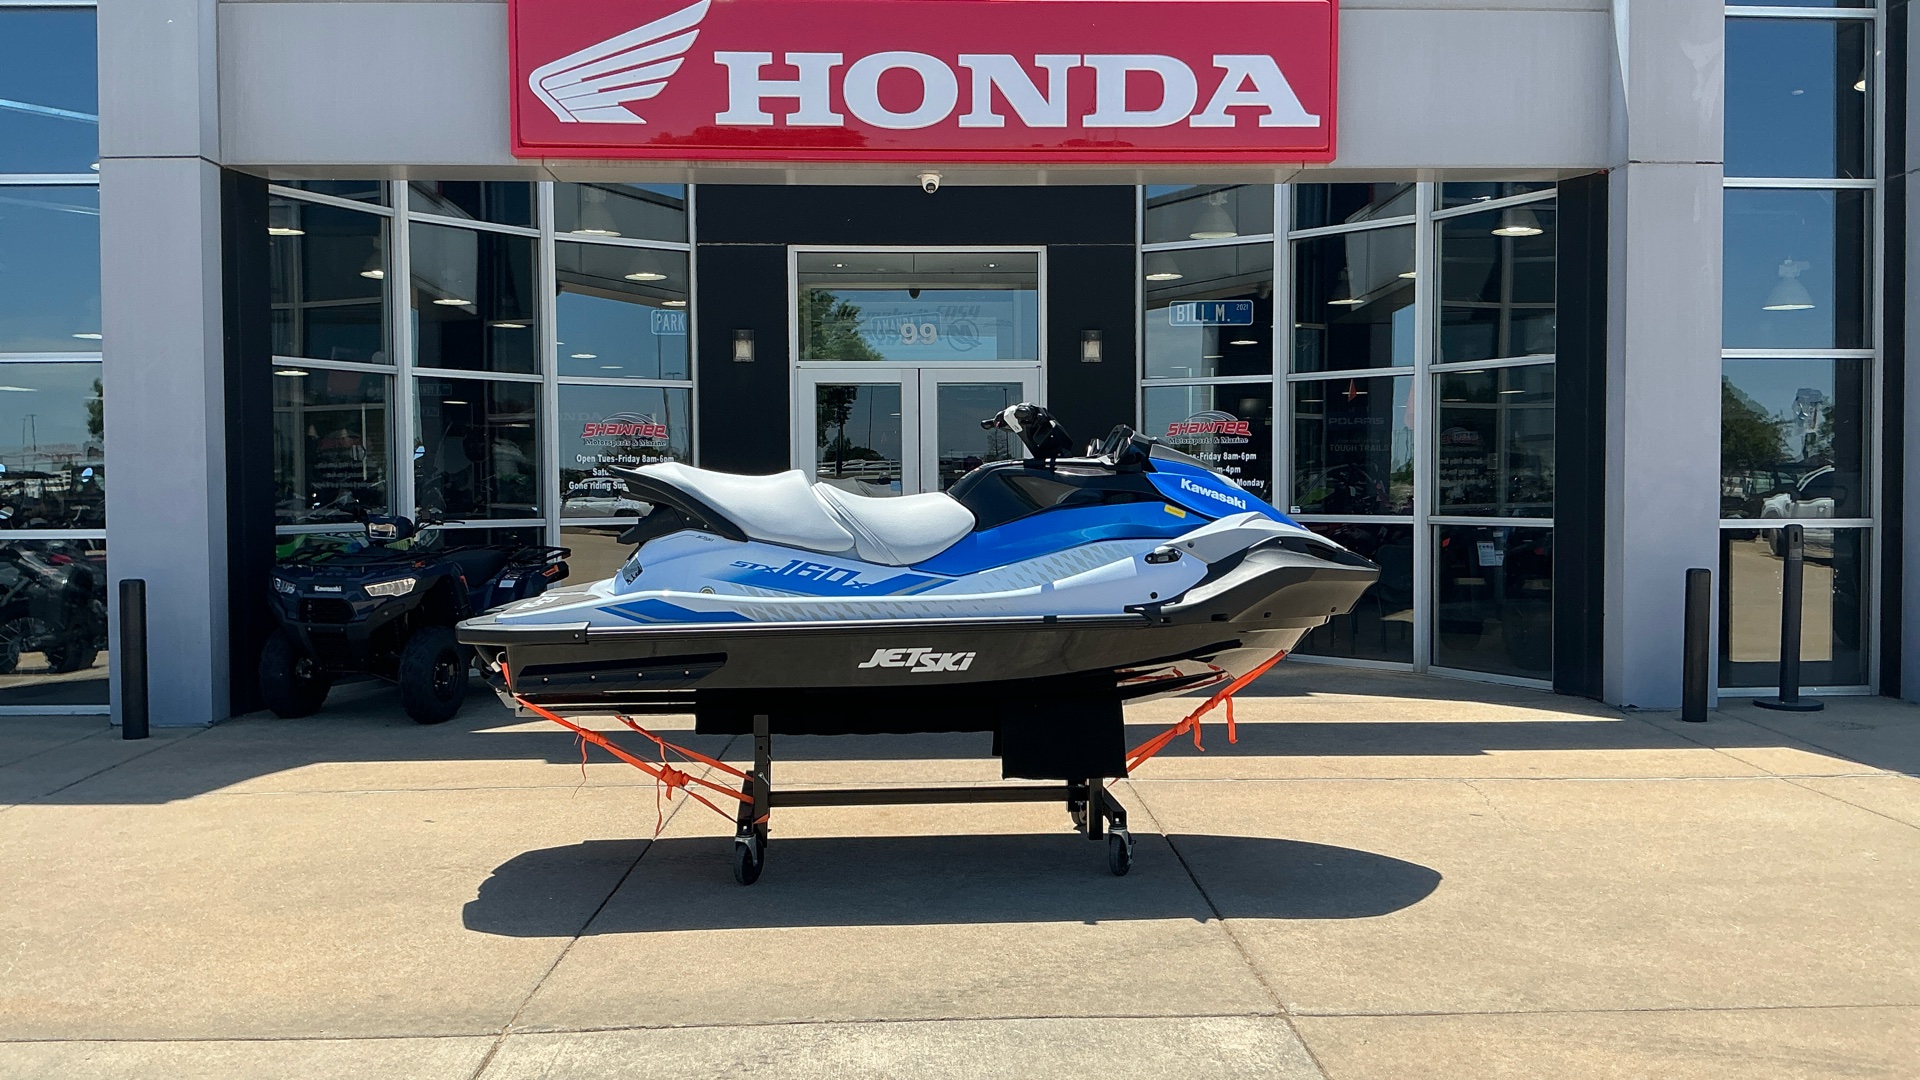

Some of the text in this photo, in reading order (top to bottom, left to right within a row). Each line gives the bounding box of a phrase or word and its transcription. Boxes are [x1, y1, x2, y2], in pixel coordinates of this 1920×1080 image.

[714, 51, 1321, 128] HONDA
[1236, 303, 1249, 311] 2021
[1176, 304, 1231, 322] BILL M.
[656, 313, 685, 331] PARK
[901, 323, 938, 345] 99
[1328, 417, 1385, 425] POLARIS
[585, 439, 631, 447] Motorsports
[1168, 437, 1212, 446] Motorsports
[1221, 436, 1249, 444] Marine
[1330, 444, 1389, 452] TOUGH TRAILS
[576, 454, 674, 464] Open Tues-Friday 8am-6pm
[1223, 452, 1257, 462] 8am-6pm
[568, 481, 588, 490] Gone
[590, 481, 611, 491] riding
[1236, 478, 1265, 489] Monday
[1181, 478, 1246, 510] Kawasaki
